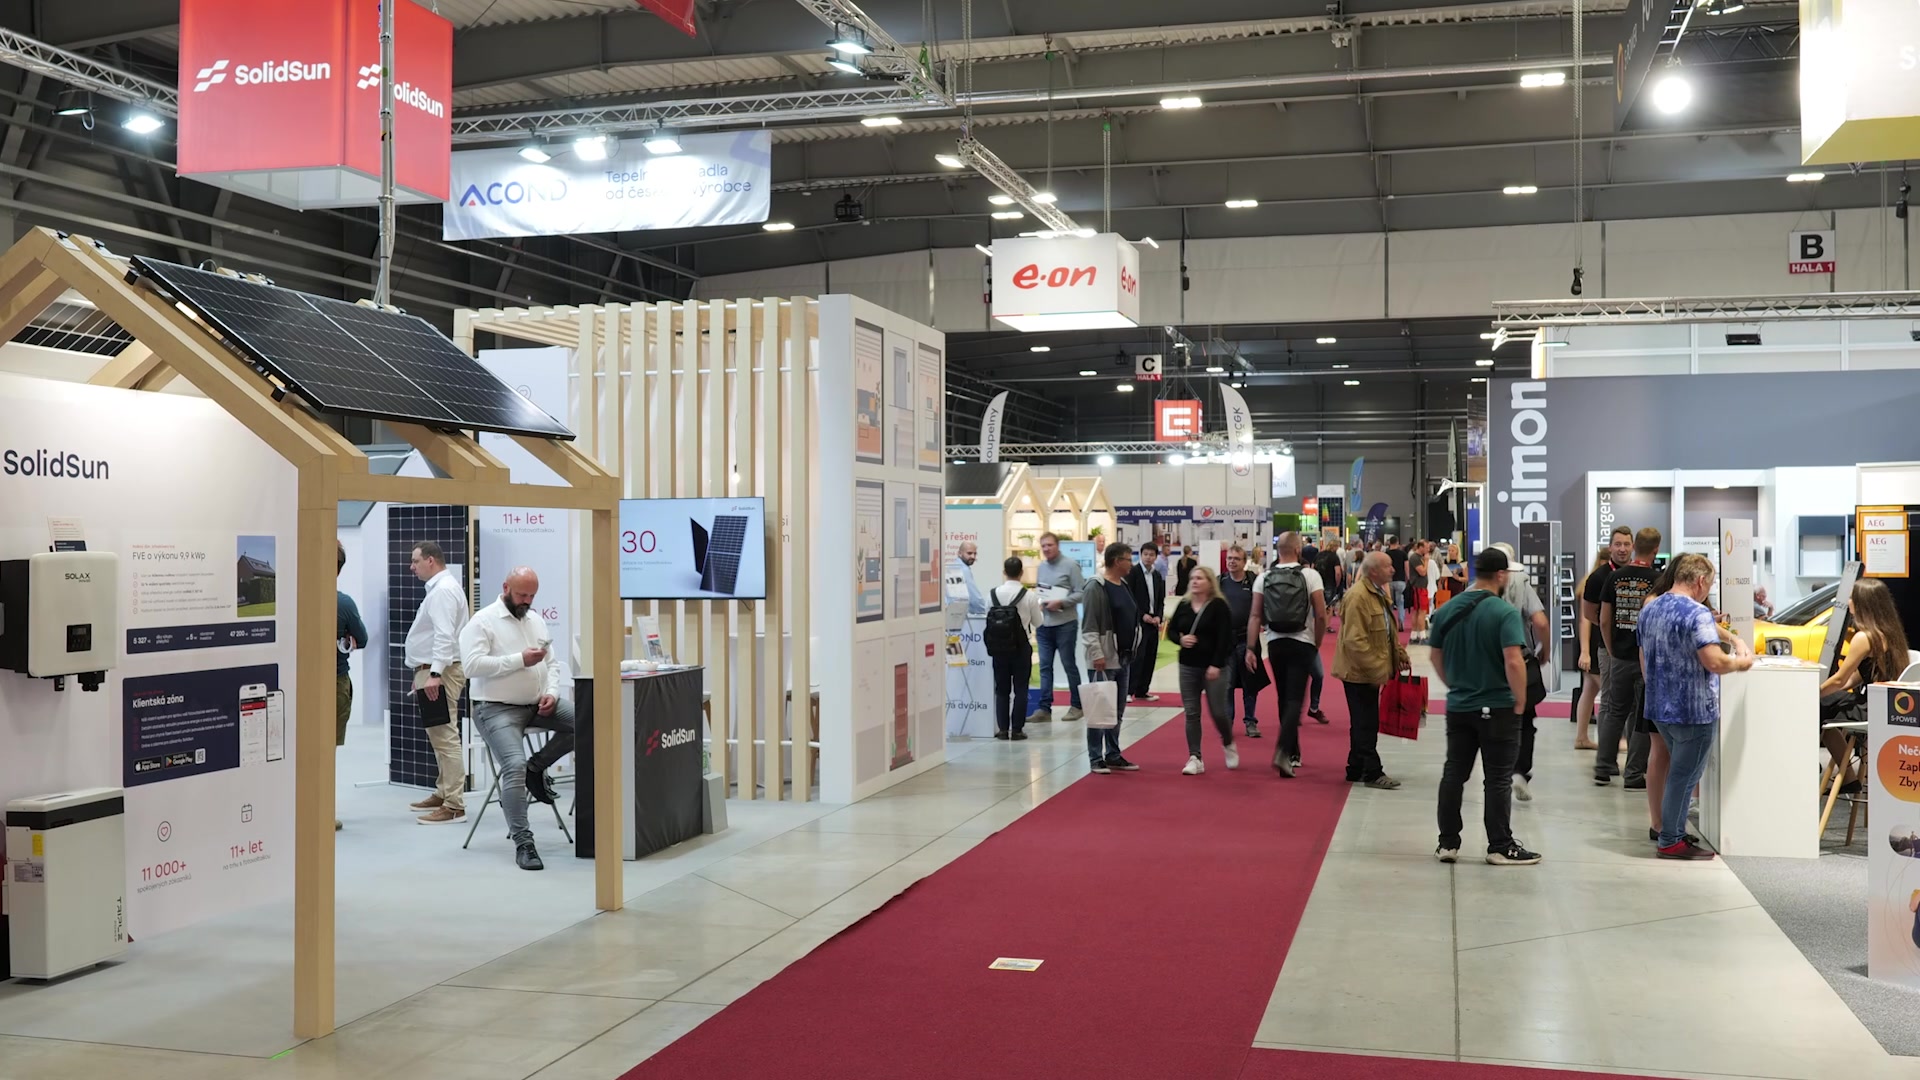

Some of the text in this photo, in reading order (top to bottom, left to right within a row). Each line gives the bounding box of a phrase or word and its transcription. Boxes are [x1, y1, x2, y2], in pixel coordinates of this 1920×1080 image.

[235, 60, 331, 85] SolidSun
[394, 82, 444, 119] olidSun
[698, 164, 728, 179] adla
[459, 180, 568, 207] ACOND
[606, 187, 624, 200] od
[1801, 234, 1824, 259] B
[1792, 263, 1833, 273] HALA 1
[1142, 357, 1155, 372] C
[3, 449, 110, 480] SolidSun
[503, 512, 545, 524] 11+ let
[1131, 509, 1155, 517] návrhy
[1215, 508, 1255, 517] koupelny
[1599, 492, 1615, 550] hargers
[622, 530, 656, 554] 30
[132, 552, 145, 560] FVE
[153, 550, 178, 562] výkonu
[180, 551, 189, 561] 9,9
[190, 551, 206, 562] kWp
[542, 606, 558, 620] Kč
[132, 693, 184, 709] Klientská zóna
[1891, 715, 1917, 724] S-POWER
[661, 728, 696, 749] SolidSun
[231, 840, 263, 859] 11+ let
[142, 860, 187, 881] 11 000+
